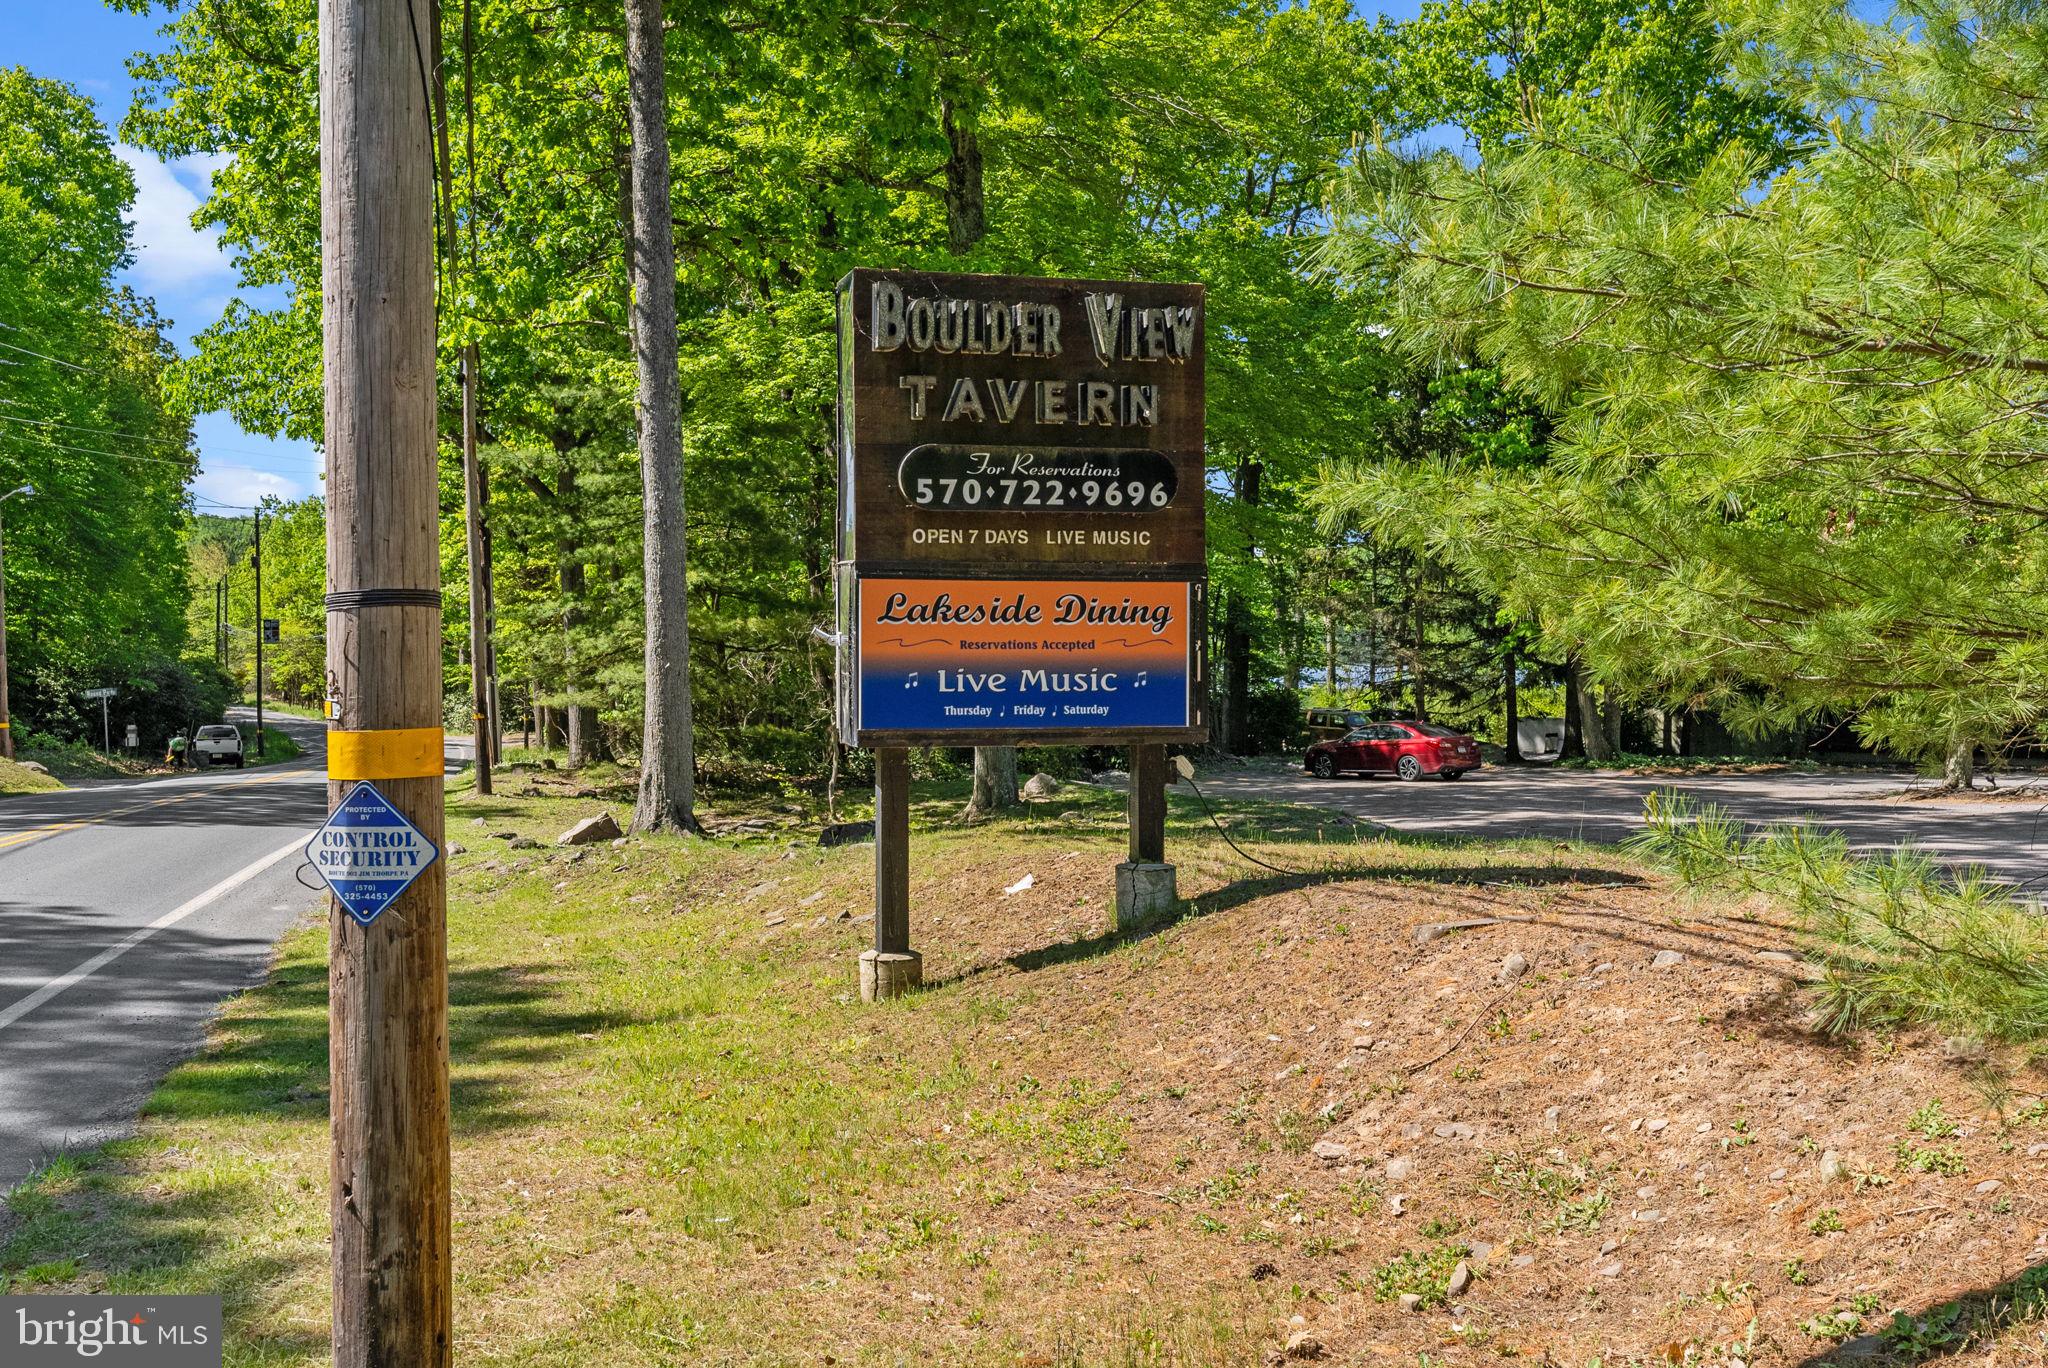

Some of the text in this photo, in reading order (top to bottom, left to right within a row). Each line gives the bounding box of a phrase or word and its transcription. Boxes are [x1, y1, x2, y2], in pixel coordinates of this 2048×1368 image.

[871, 281, 1198, 367] BOULDER VIEW
[900, 375, 1159, 427] TAVERN
[966, 452, 1121, 477] For Reservations
[912, 529, 1151, 546] OPEN 7 DAYS LIVE MUSIC
[876, 592, 1174, 636] Lakeside Dining
[959, 639, 1096, 652] Reservations Accepted
[938, 667, 1118, 693] Live Music
[944, 704, 1109, 717] Thursday Friday Saturday
[322, 831, 417, 848] CONTROL
[319, 850, 420, 867] SECURITY
